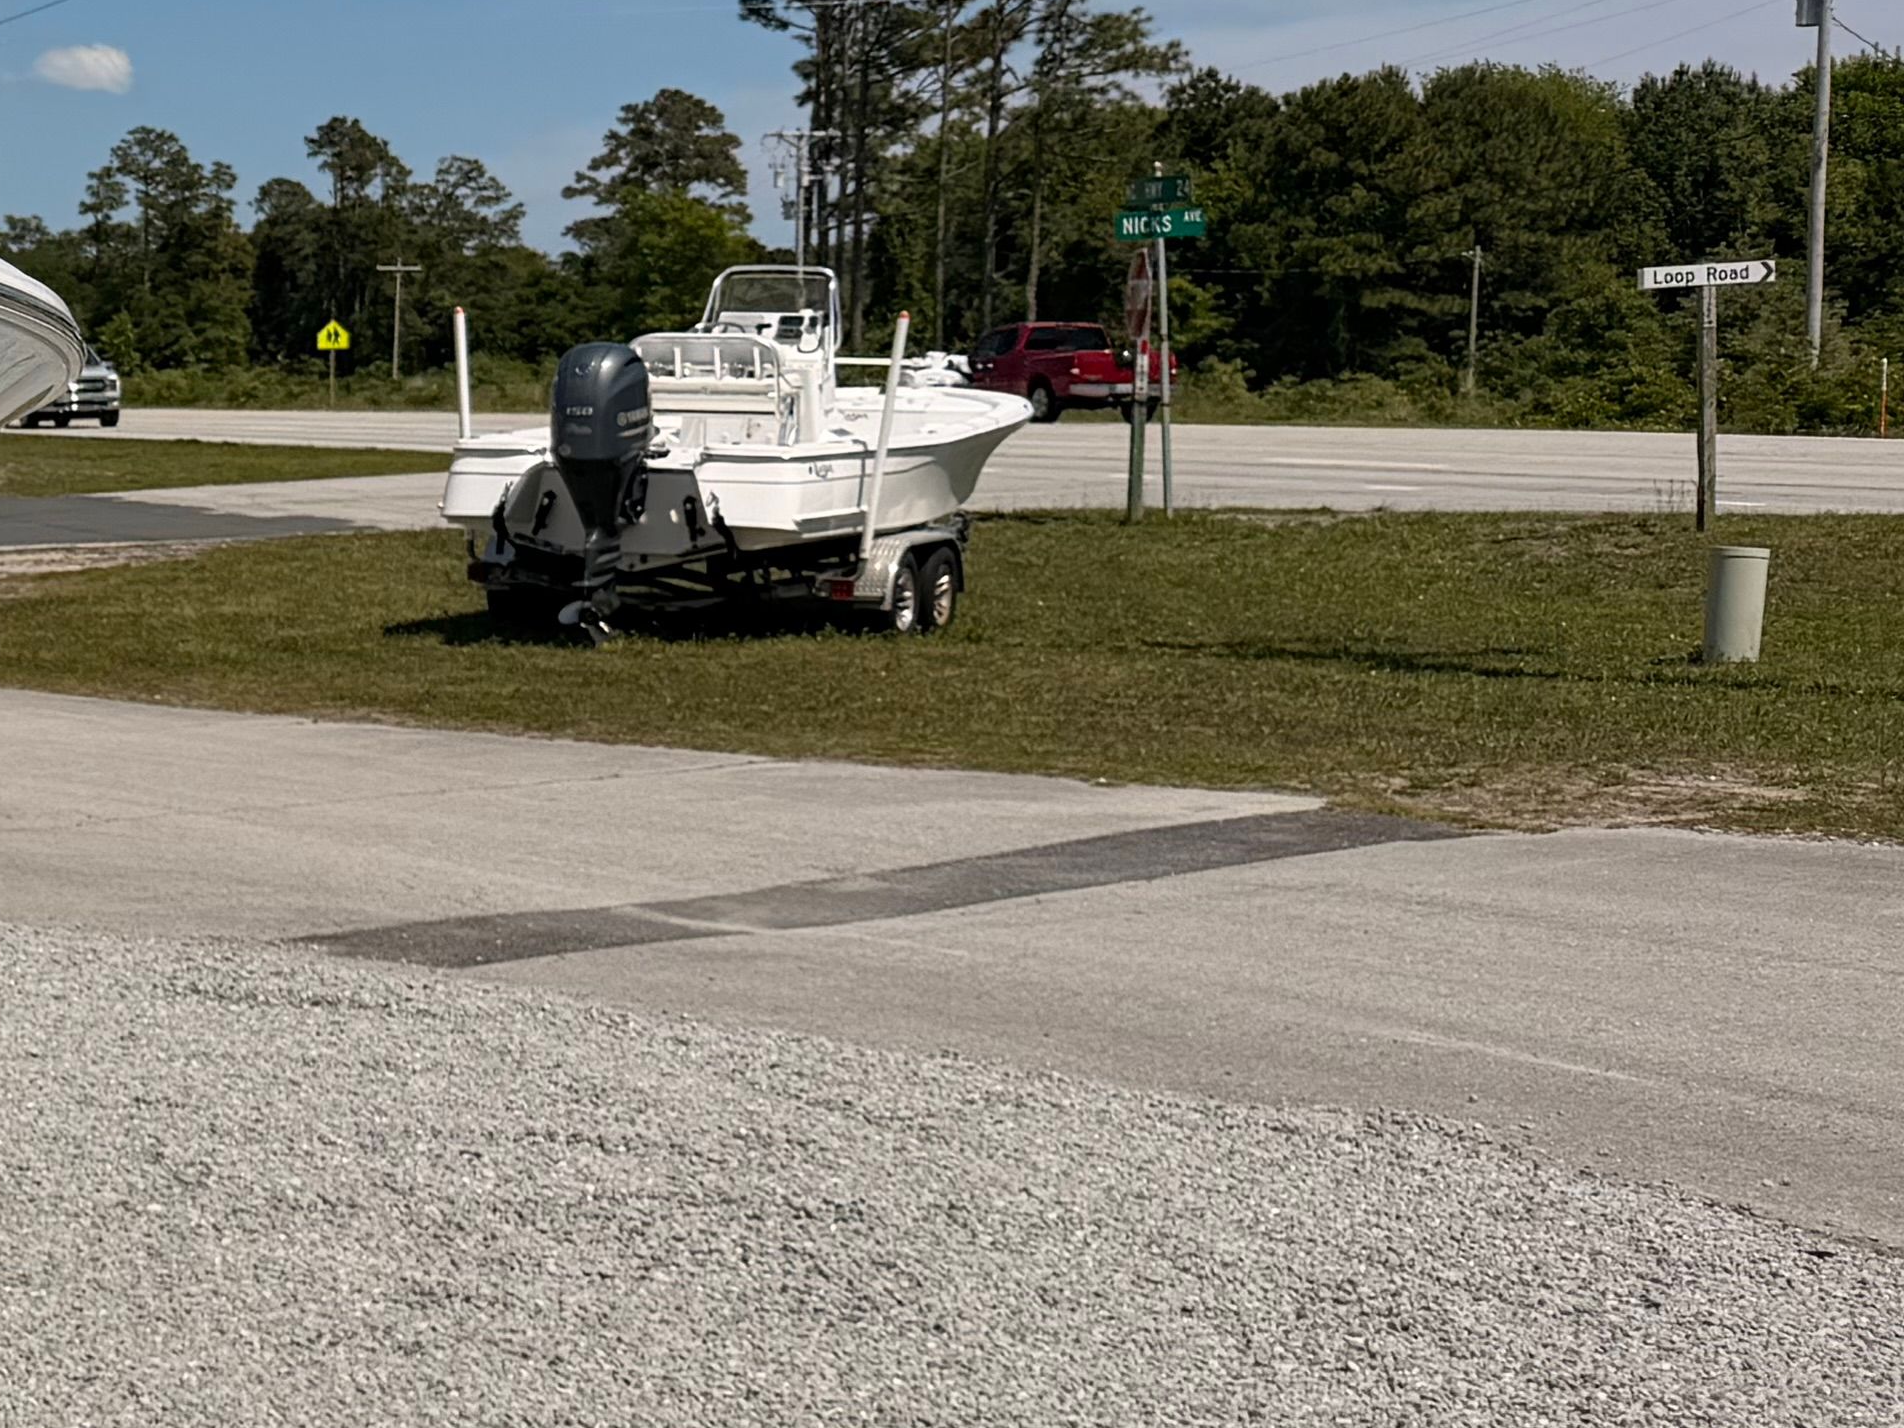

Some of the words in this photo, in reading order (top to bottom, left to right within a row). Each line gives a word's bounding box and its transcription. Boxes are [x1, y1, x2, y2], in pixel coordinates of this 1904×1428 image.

[1122, 214, 1172, 234] NICKS
[1183, 209, 1202, 222] AVE
[1653, 270, 1695, 287] Loop
[1706, 265, 1750, 283] Road
